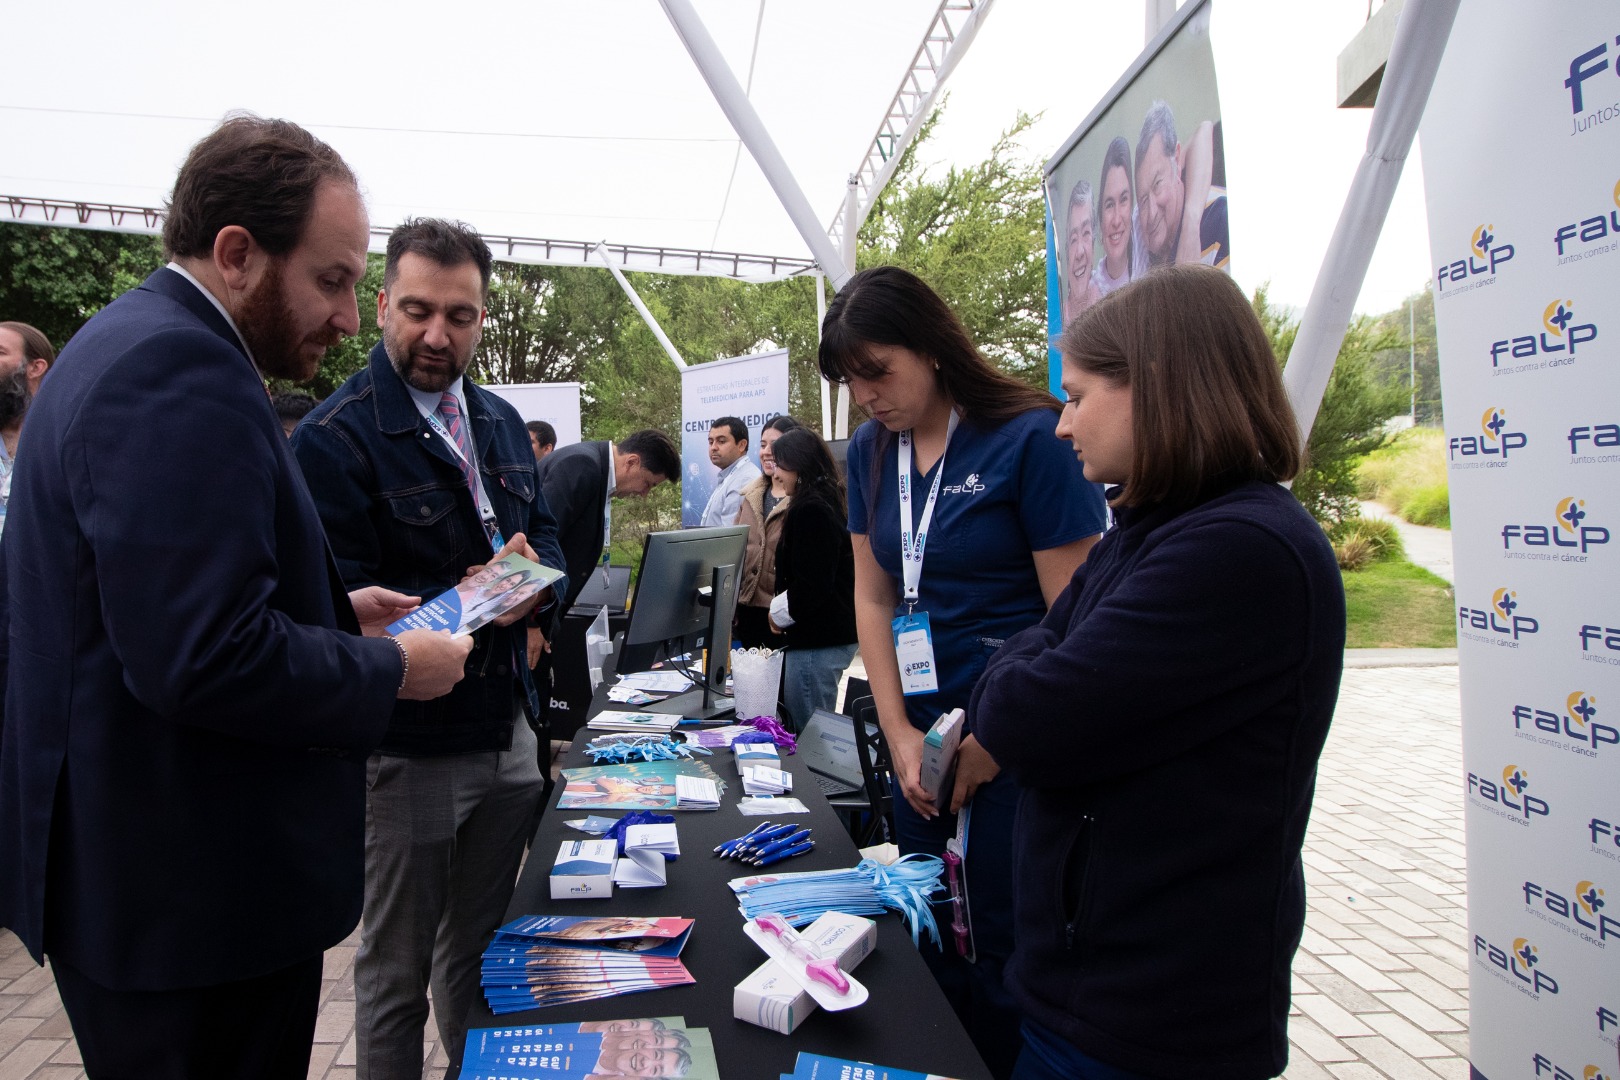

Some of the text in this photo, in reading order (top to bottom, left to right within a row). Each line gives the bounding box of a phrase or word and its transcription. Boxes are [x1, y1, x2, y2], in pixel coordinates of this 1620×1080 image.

[1564, 34, 1620, 114] f
[1571, 103, 1620, 136] Juntos
[1557, 240, 1618, 266] Juntos contra el
[1475, 276, 1497, 288] cáncer
[1492, 357, 1576, 377] Juntos contra el cáncer
[761, 376, 770, 384] DE
[700, 388, 766, 404] TELEMEDICINA PARA APS
[685, 419, 716, 432] CENTR
[1486, 459, 1508, 468] cáncer
[1569, 455, 1596, 464] Juntos
[914, 532, 923, 553] EXPO
[1504, 550, 1588, 563] Juntos contra el cáncer
[1496, 639, 1520, 649] cáncer
[912, 661, 930, 670] EXPO
[1581, 651, 1607, 664] Juntos
[1514, 729, 1598, 758] Juntos contra el cáncer
[1588, 818, 1620, 848] f
[1590, 843, 1616, 861] Juntos
[1525, 905, 1606, 949] Juntos contra el cáncer
